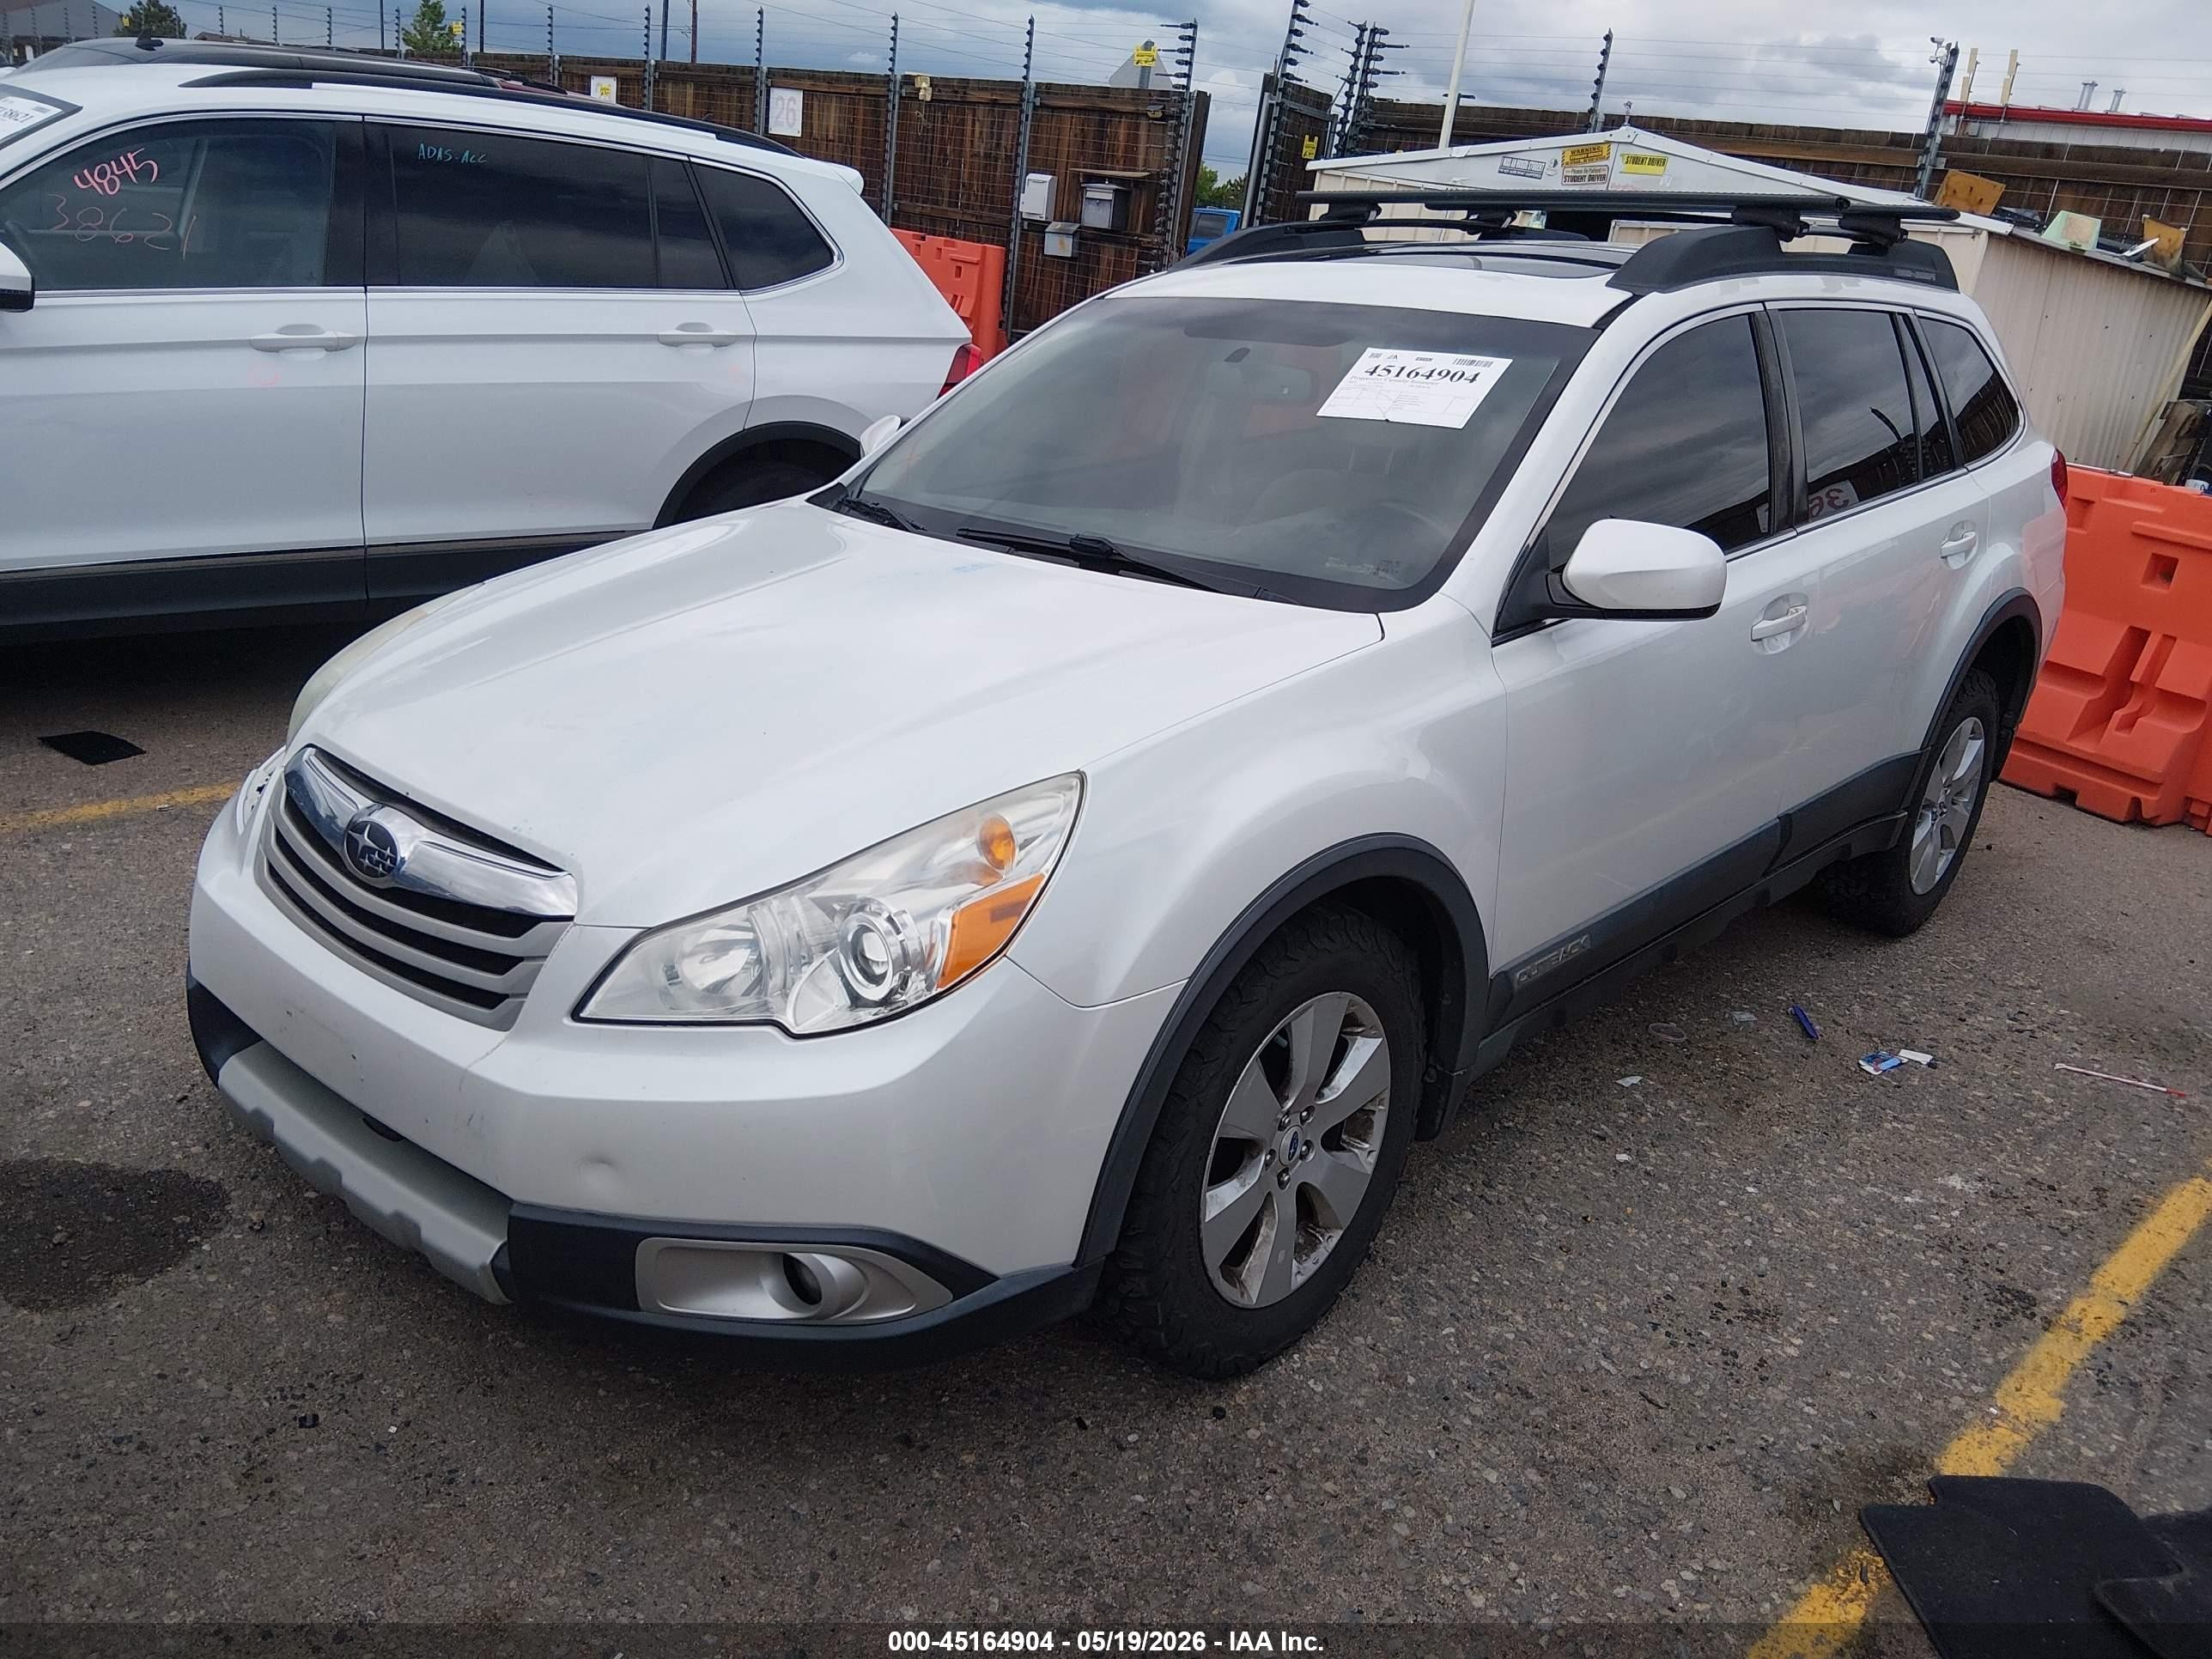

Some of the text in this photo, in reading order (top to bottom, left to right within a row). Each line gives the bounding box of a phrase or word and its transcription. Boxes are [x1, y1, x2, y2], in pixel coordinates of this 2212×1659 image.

[775, 94, 797, 128] 26
[74, 148, 158, 195] 4845
[1626, 155, 1667, 167] STUDENT DRIVER
[1564, 173, 1607, 183] STUDENT DRIVER
[48, 193, 197, 259] 38621
[1364, 364, 1480, 384] 45164904
